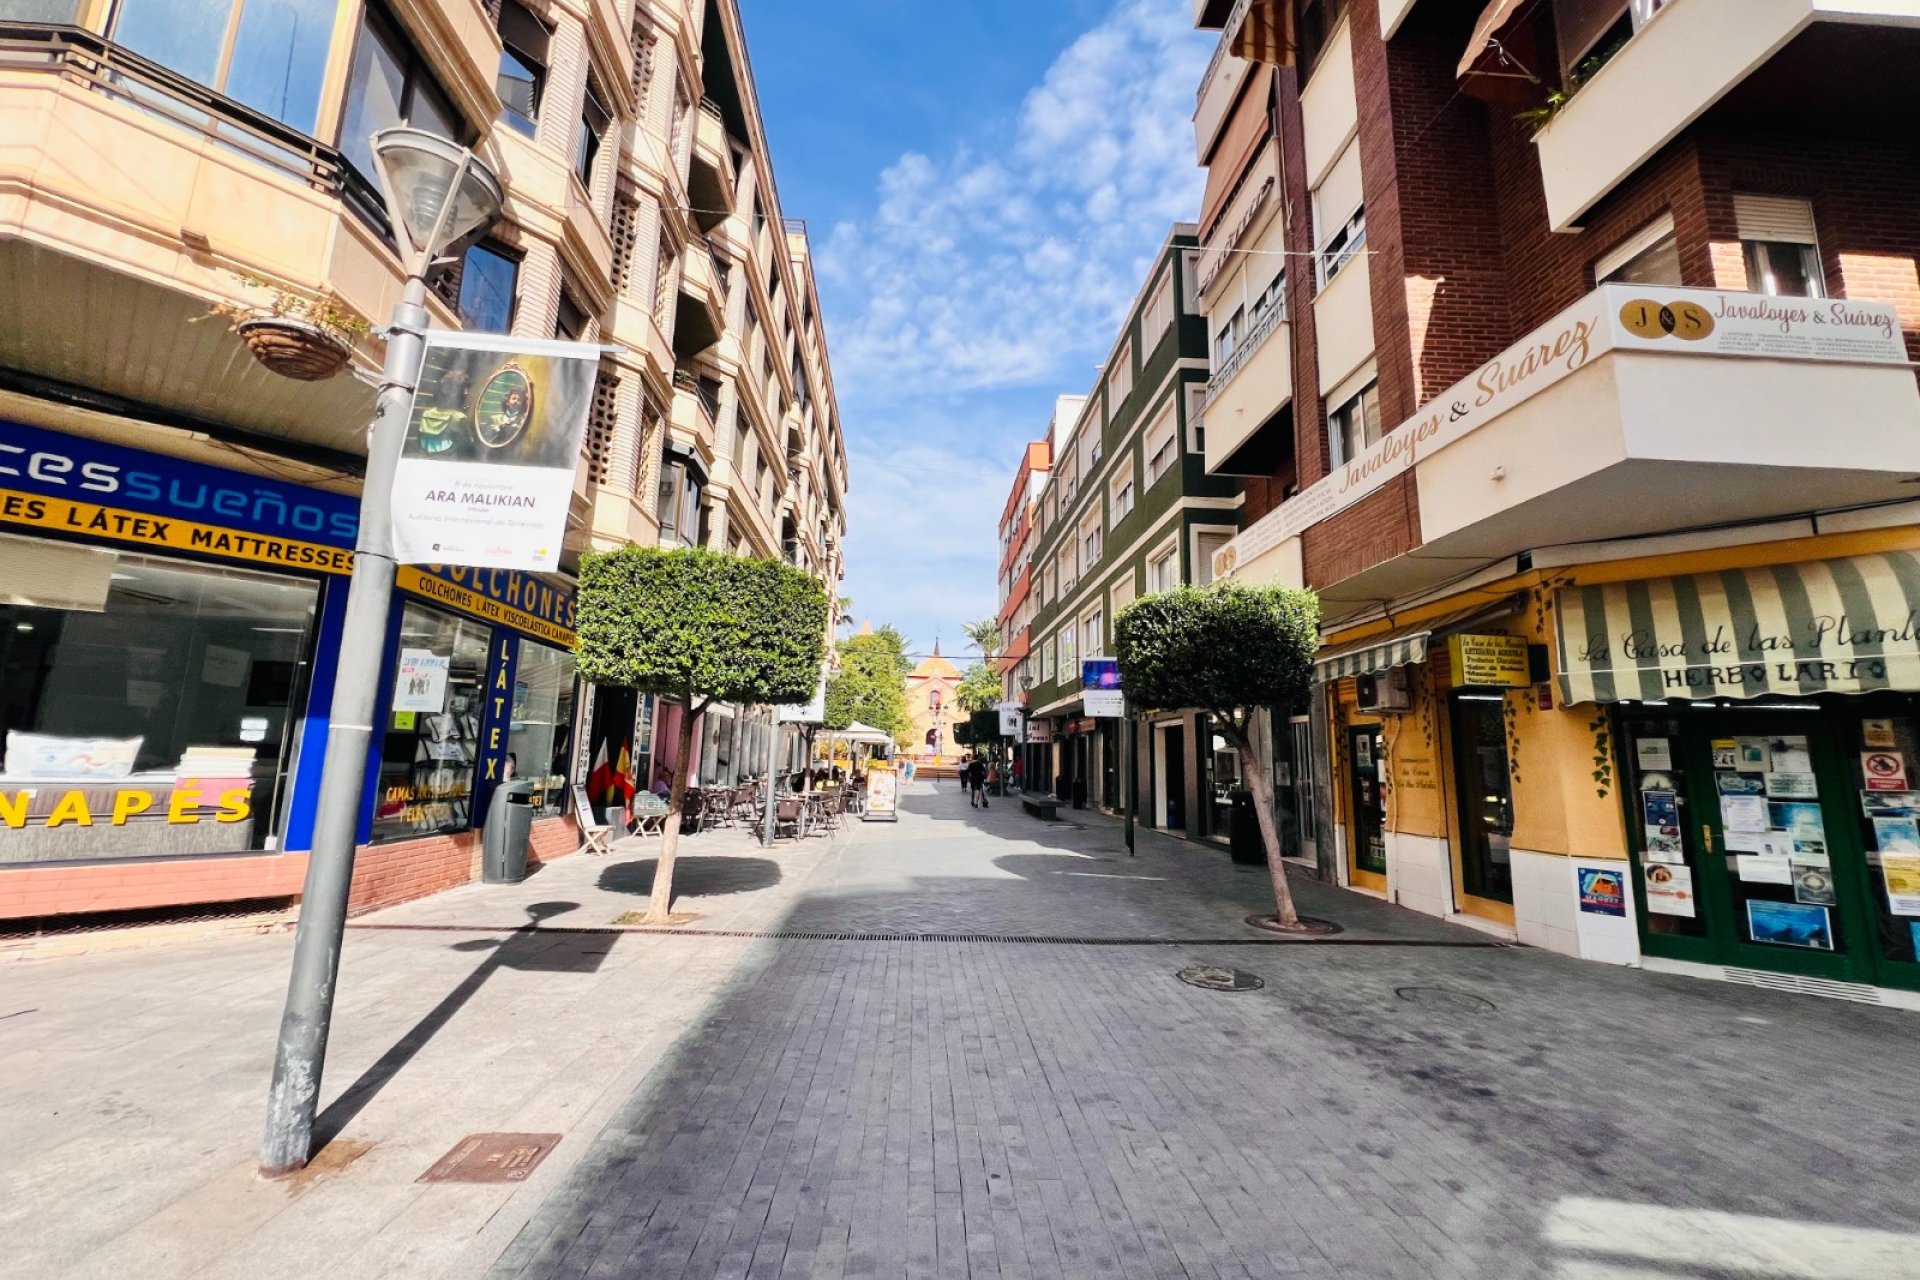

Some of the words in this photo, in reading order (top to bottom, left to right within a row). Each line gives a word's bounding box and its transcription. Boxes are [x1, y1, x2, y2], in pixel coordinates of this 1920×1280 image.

[1635, 306, 1647, 328] J
[1684, 308, 1702, 329] S
[1715, 295, 1808, 333] Javaloyes
[1813, 309, 1828, 325] &
[1830, 302, 1895, 338] Suárez
[1338, 410, 1445, 495] Javaloyes
[1449, 400, 1470, 423] &
[1474, 315, 1598, 408] Suárez
[123, 470, 359, 539] sueños
[425, 490, 456, 504] ARA
[460, 491, 536, 509] MALIKIAN
[67, 507, 171, 541] LÁTEX
[191, 529, 356, 571] MATTRESSES
[419, 576, 473, 608] COLCHONES
[476, 598, 501, 618] LÁTEX
[503, 608, 552, 635] VISCOELÁSTICA
[1577, 632, 1611, 663] La
[1620, 630, 1689, 660] Casa
[1701, 625, 1731, 655] de
[1748, 621, 1795, 651] las
[1662, 661, 1887, 689] HERBOLARIO
[485, 639, 510, 780] LÁTEX
[386, 785, 415, 802] CAMAS
